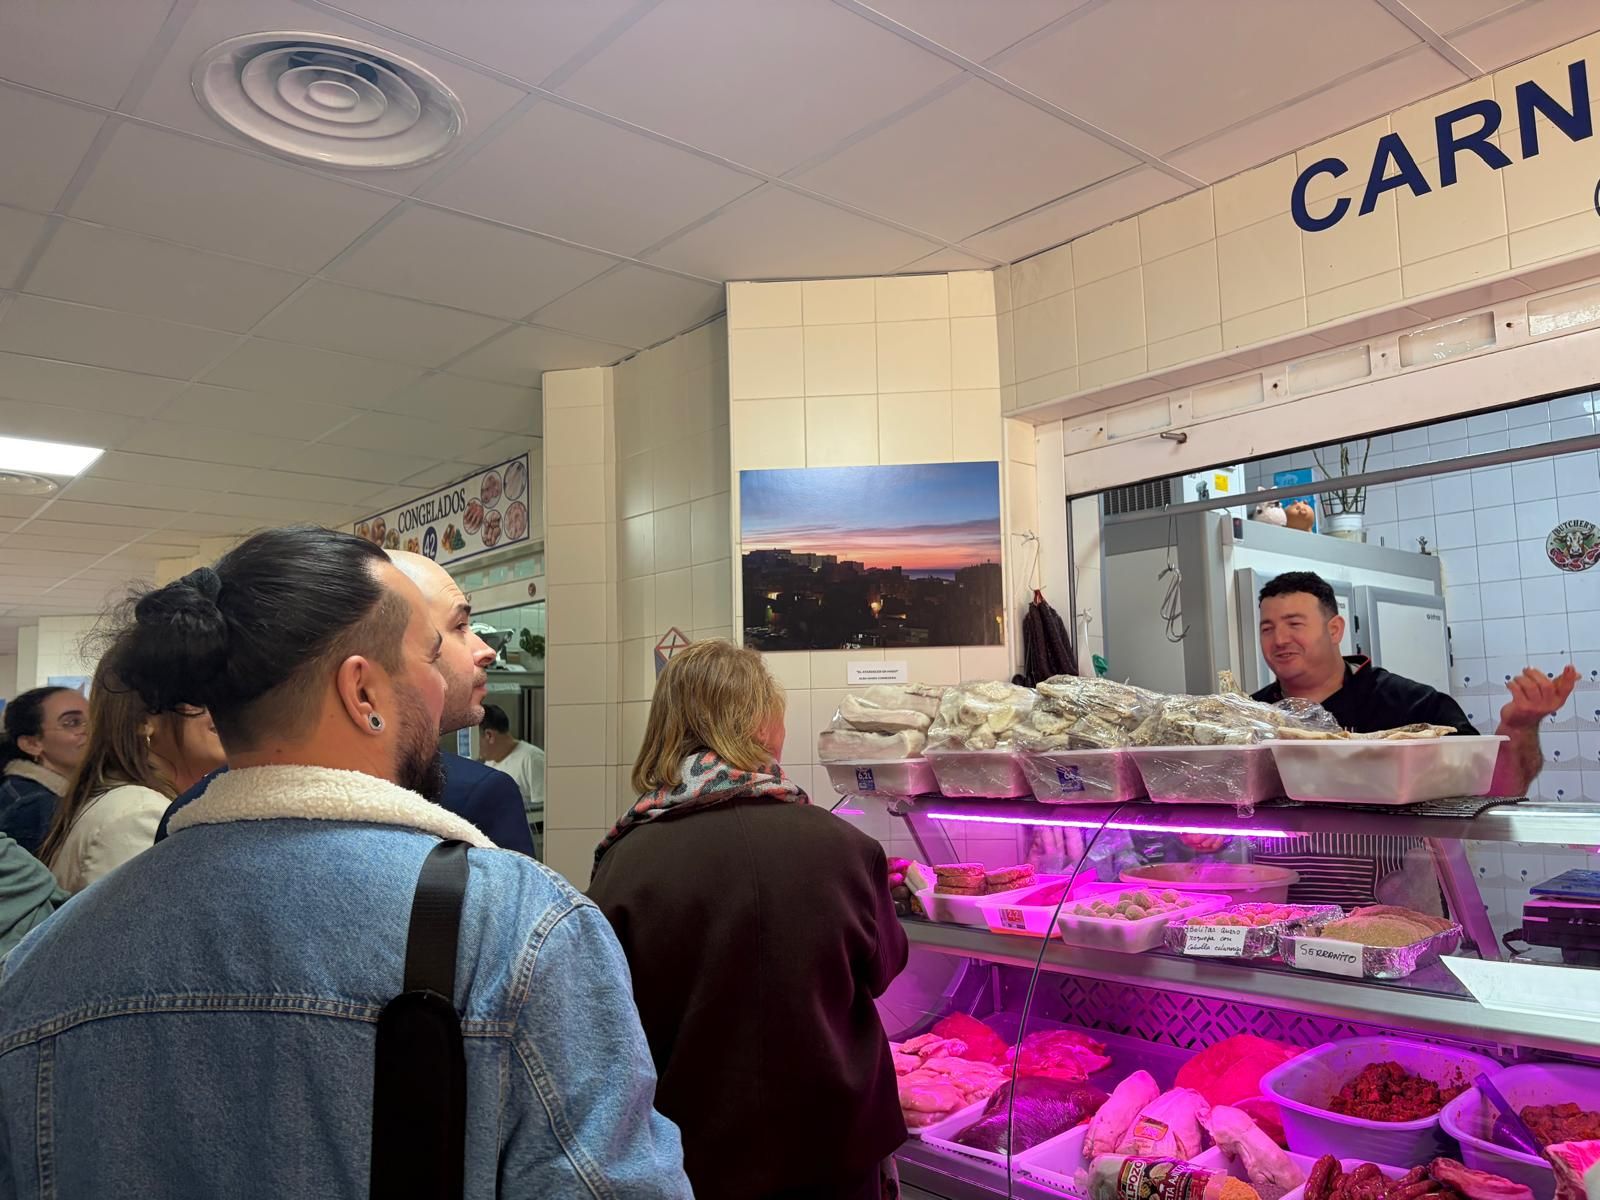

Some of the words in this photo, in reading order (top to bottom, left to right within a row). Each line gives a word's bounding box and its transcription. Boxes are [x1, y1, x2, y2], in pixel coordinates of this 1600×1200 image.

[1291, 59, 1593, 232] CARN
[398, 488, 466, 534] CONGELADOS
[423, 533, 436, 557] 42
[1127, 1161, 1144, 1200] LPOZO
